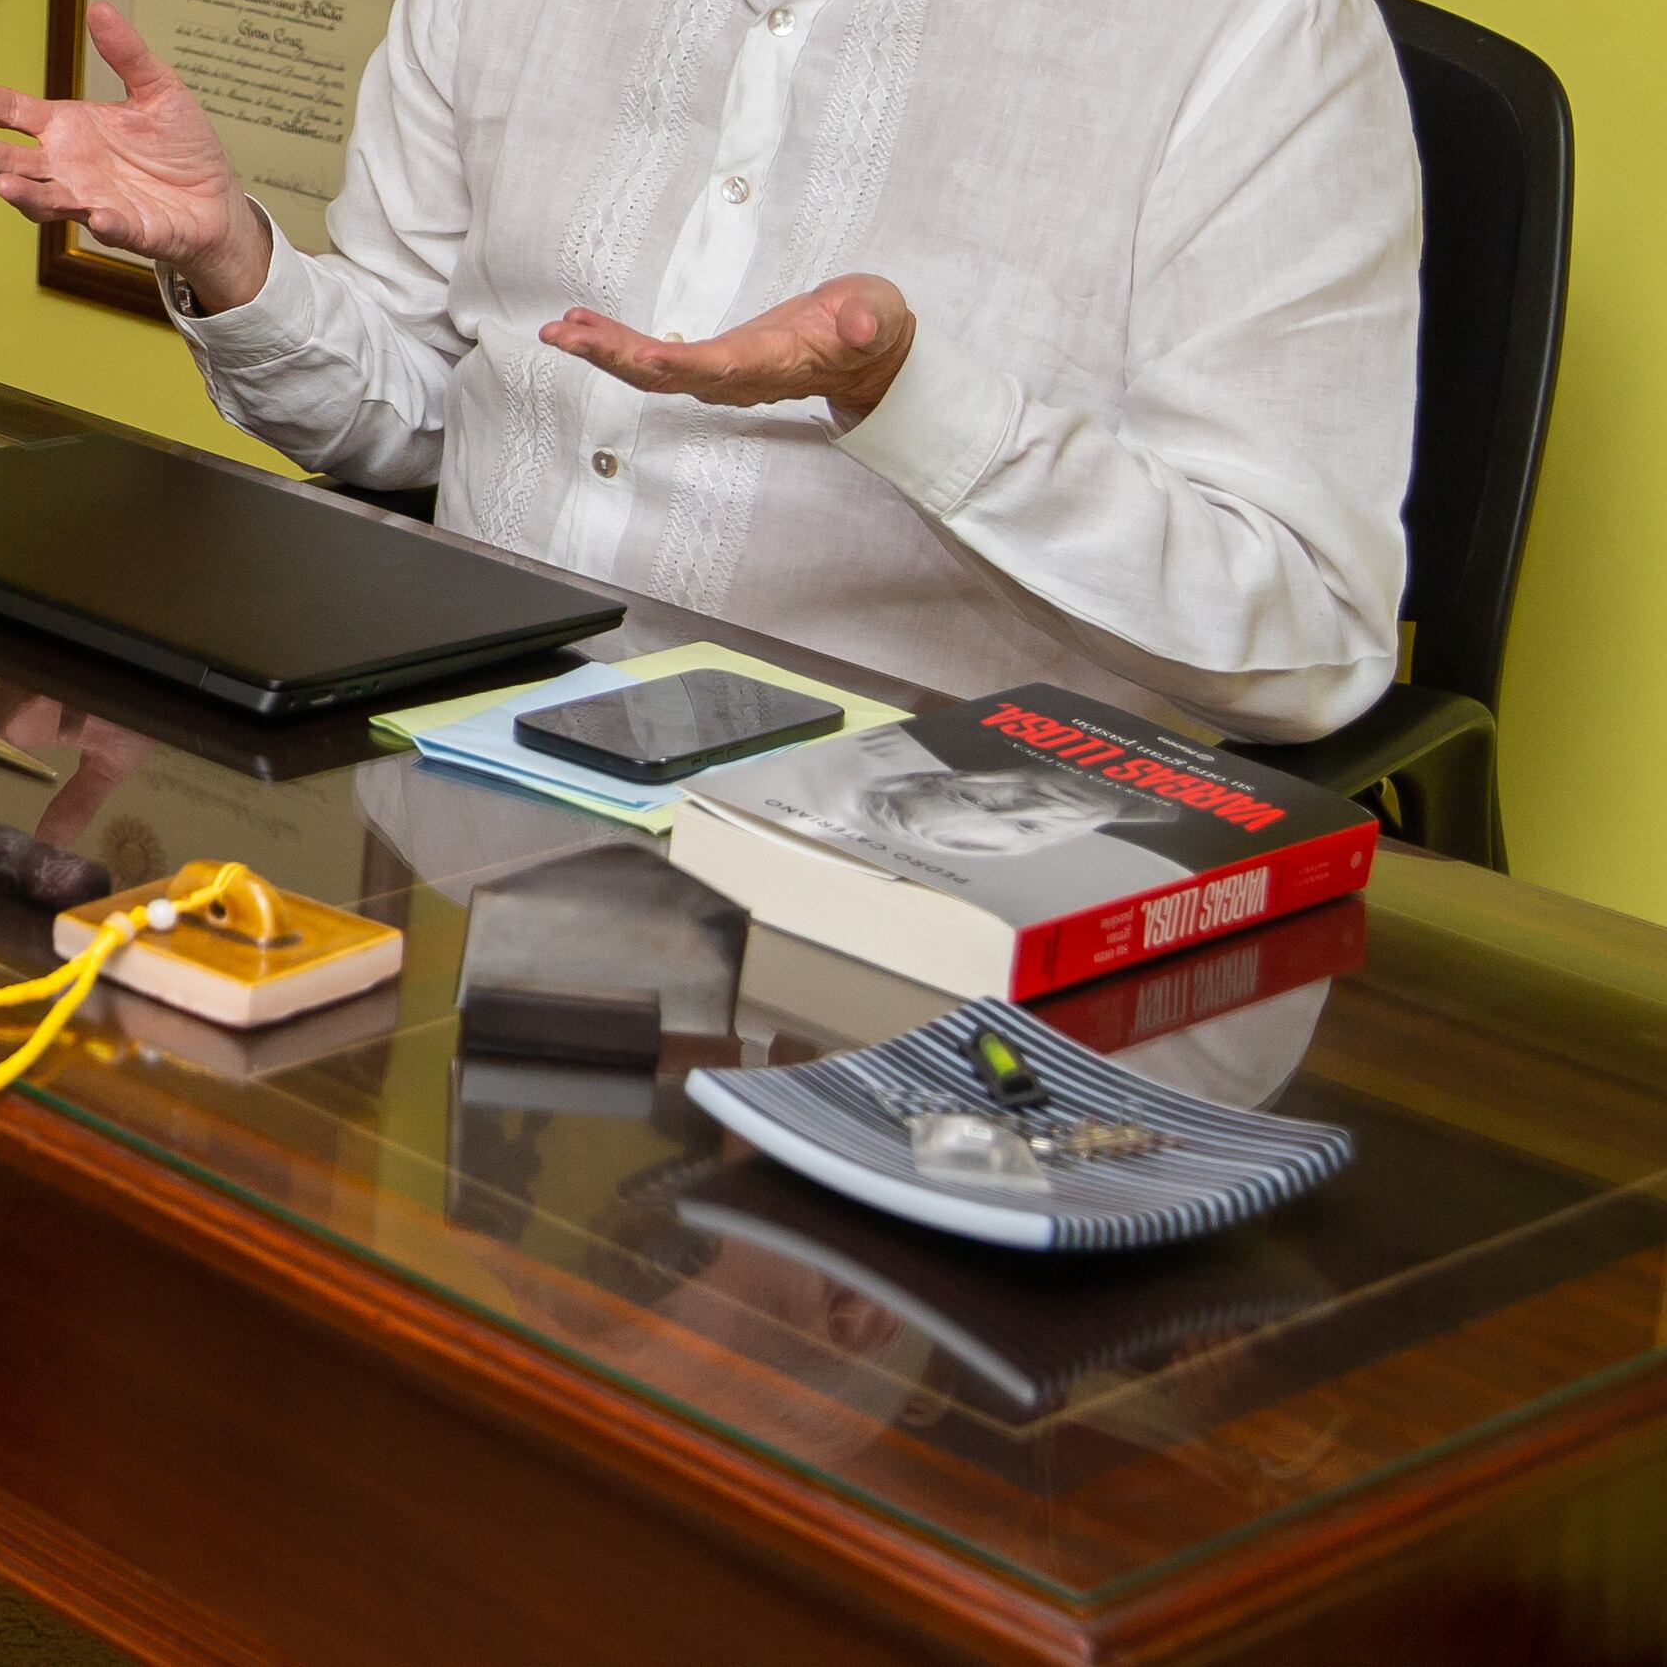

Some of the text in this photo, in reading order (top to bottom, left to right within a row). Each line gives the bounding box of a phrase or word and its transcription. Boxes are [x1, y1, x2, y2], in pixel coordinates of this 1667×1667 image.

[1071, 717, 1256, 792] su otra gran pasión
[1156, 735, 1199, 757] Planeta
[1102, 757, 1287, 833] VARGAS
[763, 796, 972, 887] PEDRO CATERIANO
[1198, 865, 1272, 932] VARGAS
